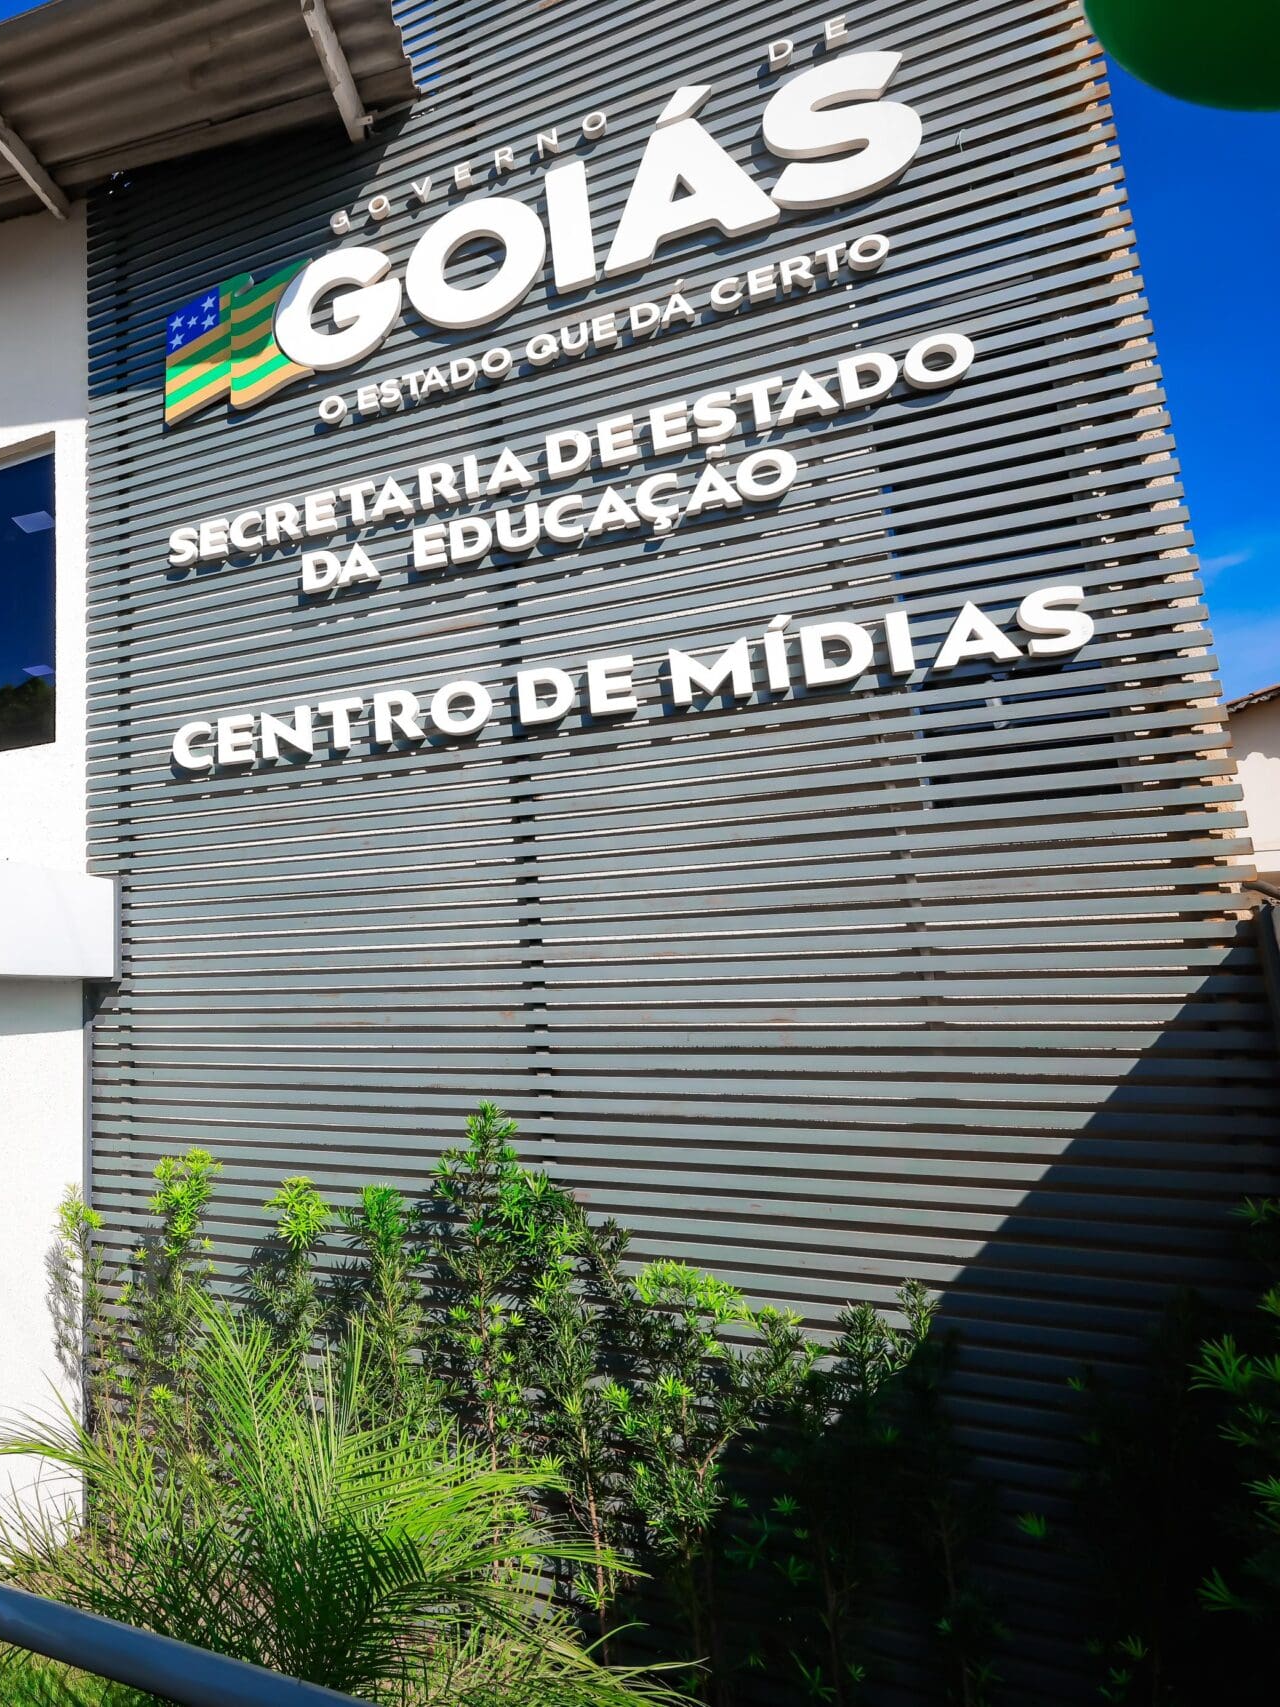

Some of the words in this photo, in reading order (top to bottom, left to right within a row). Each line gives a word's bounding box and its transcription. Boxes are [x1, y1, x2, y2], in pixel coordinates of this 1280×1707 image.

[768, 15, 848, 72] DE
[273, 51, 923, 371] GOIÁS
[330, 111, 608, 235] GOVERNO
[318, 395, 348, 425] O
[357, 348, 513, 415] ESTADO
[525, 313, 617, 366] QUE
[629, 279, 695, 338] DÁ
[710, 234, 890, 312] CERTO
[167, 446, 534, 568] SECRETARIA
[545, 414, 638, 480] DE
[649, 332, 976, 455] ESTADO
[302, 542, 382, 595] DA
[413, 444, 798, 572] EDUCAÇÃO
[172, 680, 494, 771] CENTRO
[517, 655, 638, 726] DE
[668, 585, 1095, 706] MÍDIAS
